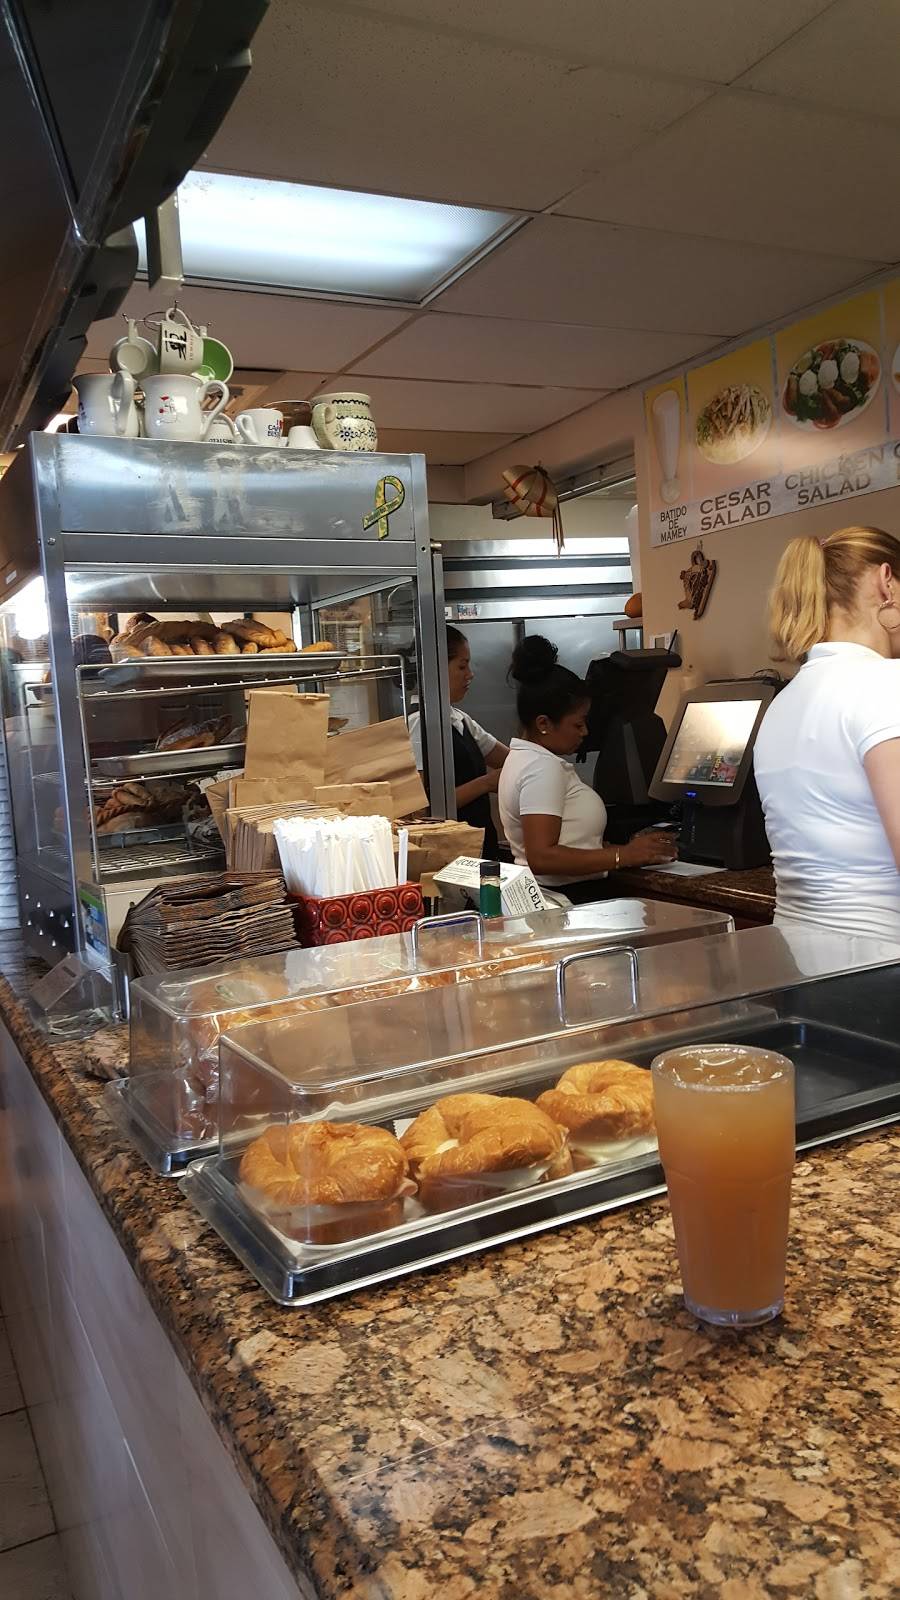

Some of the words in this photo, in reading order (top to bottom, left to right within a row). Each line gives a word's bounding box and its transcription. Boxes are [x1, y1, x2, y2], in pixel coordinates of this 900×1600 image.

[785, 447, 884, 490] CHICKEN
[700, 482, 772, 514] CESAR
[798, 474, 871, 505] SALAD
[660, 505, 687, 522] BATIDO
[668, 518, 679, 530] DE
[701, 500, 772, 531] SALAD
[660, 526, 687, 543] MAMEY
